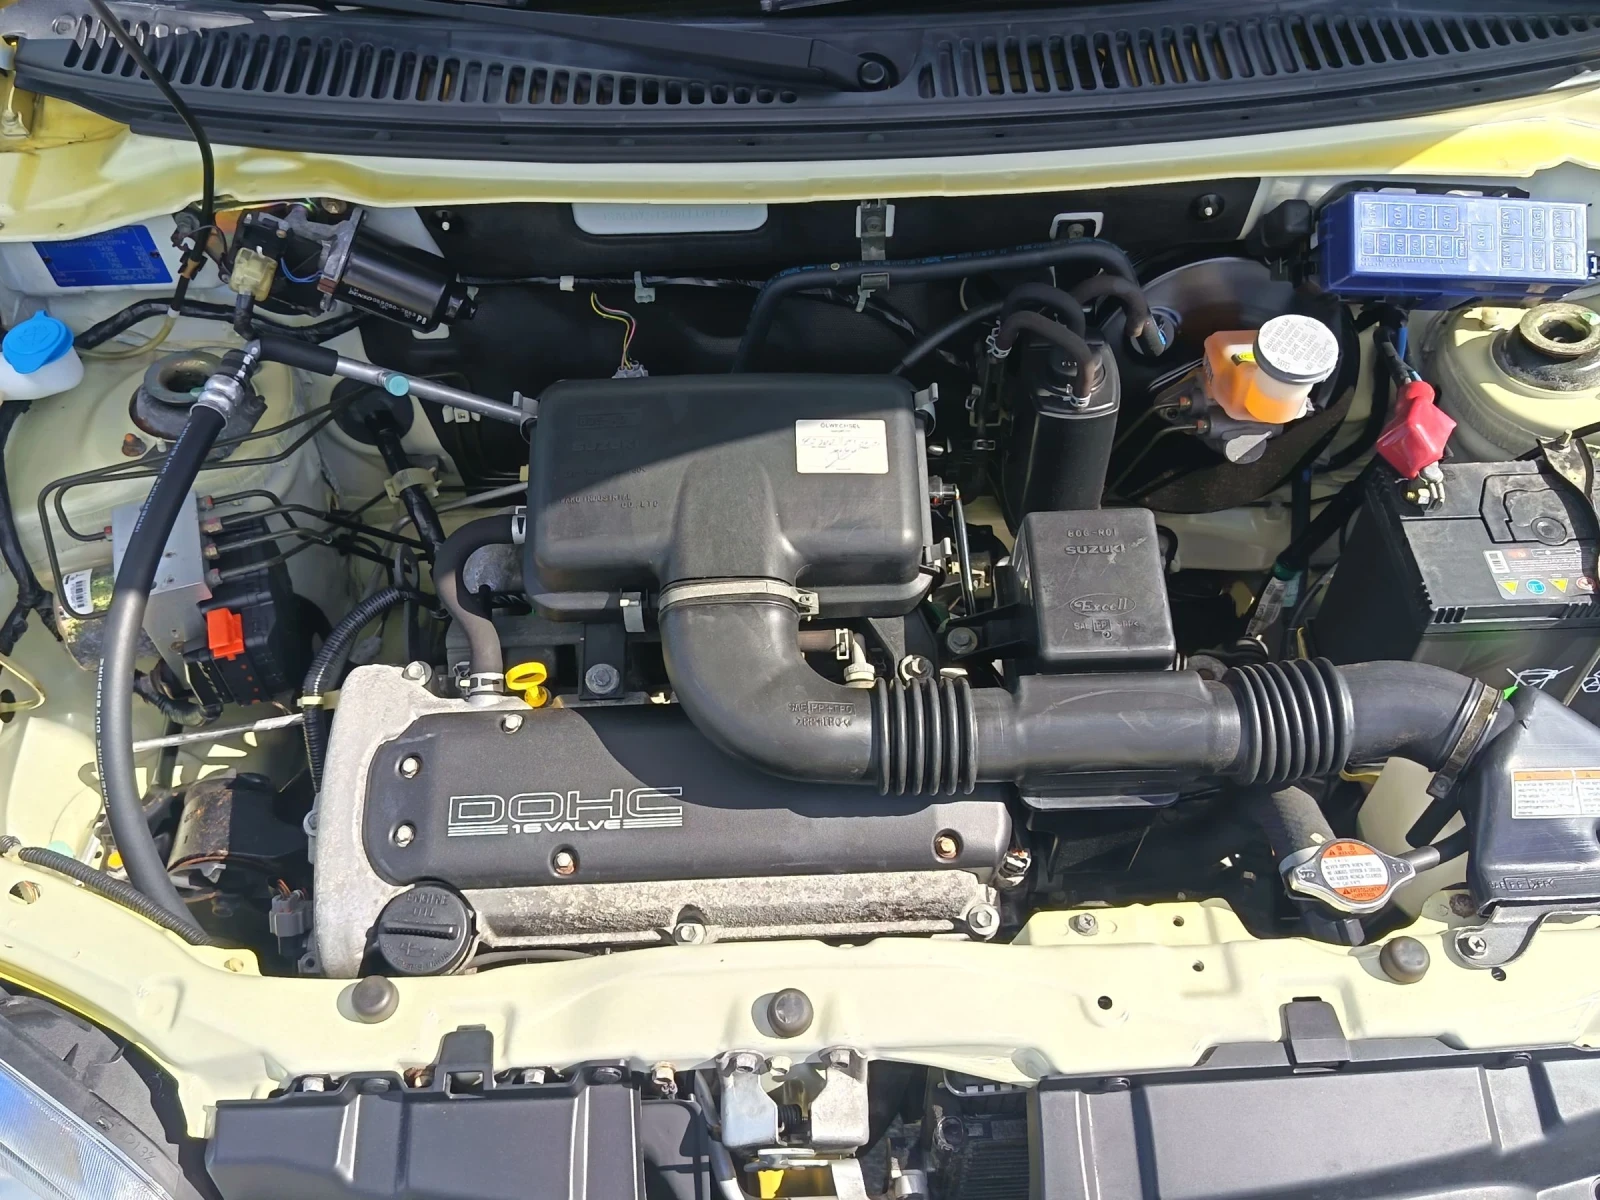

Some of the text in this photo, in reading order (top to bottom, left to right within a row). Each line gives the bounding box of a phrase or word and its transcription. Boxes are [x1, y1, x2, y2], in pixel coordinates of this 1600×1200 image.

[1394, 206, 1404, 226] 60A
[1418, 206, 1428, 227] 50A
[1477, 228, 1487, 247] 80A
[347, 289, 373, 302] DENSO
[1064, 543, 1127, 556] SUZUKI
[1073, 597, 1129, 612] Excell
[448, 787, 683, 827] DOHC
[406, 892, 450, 906] ENGINE
